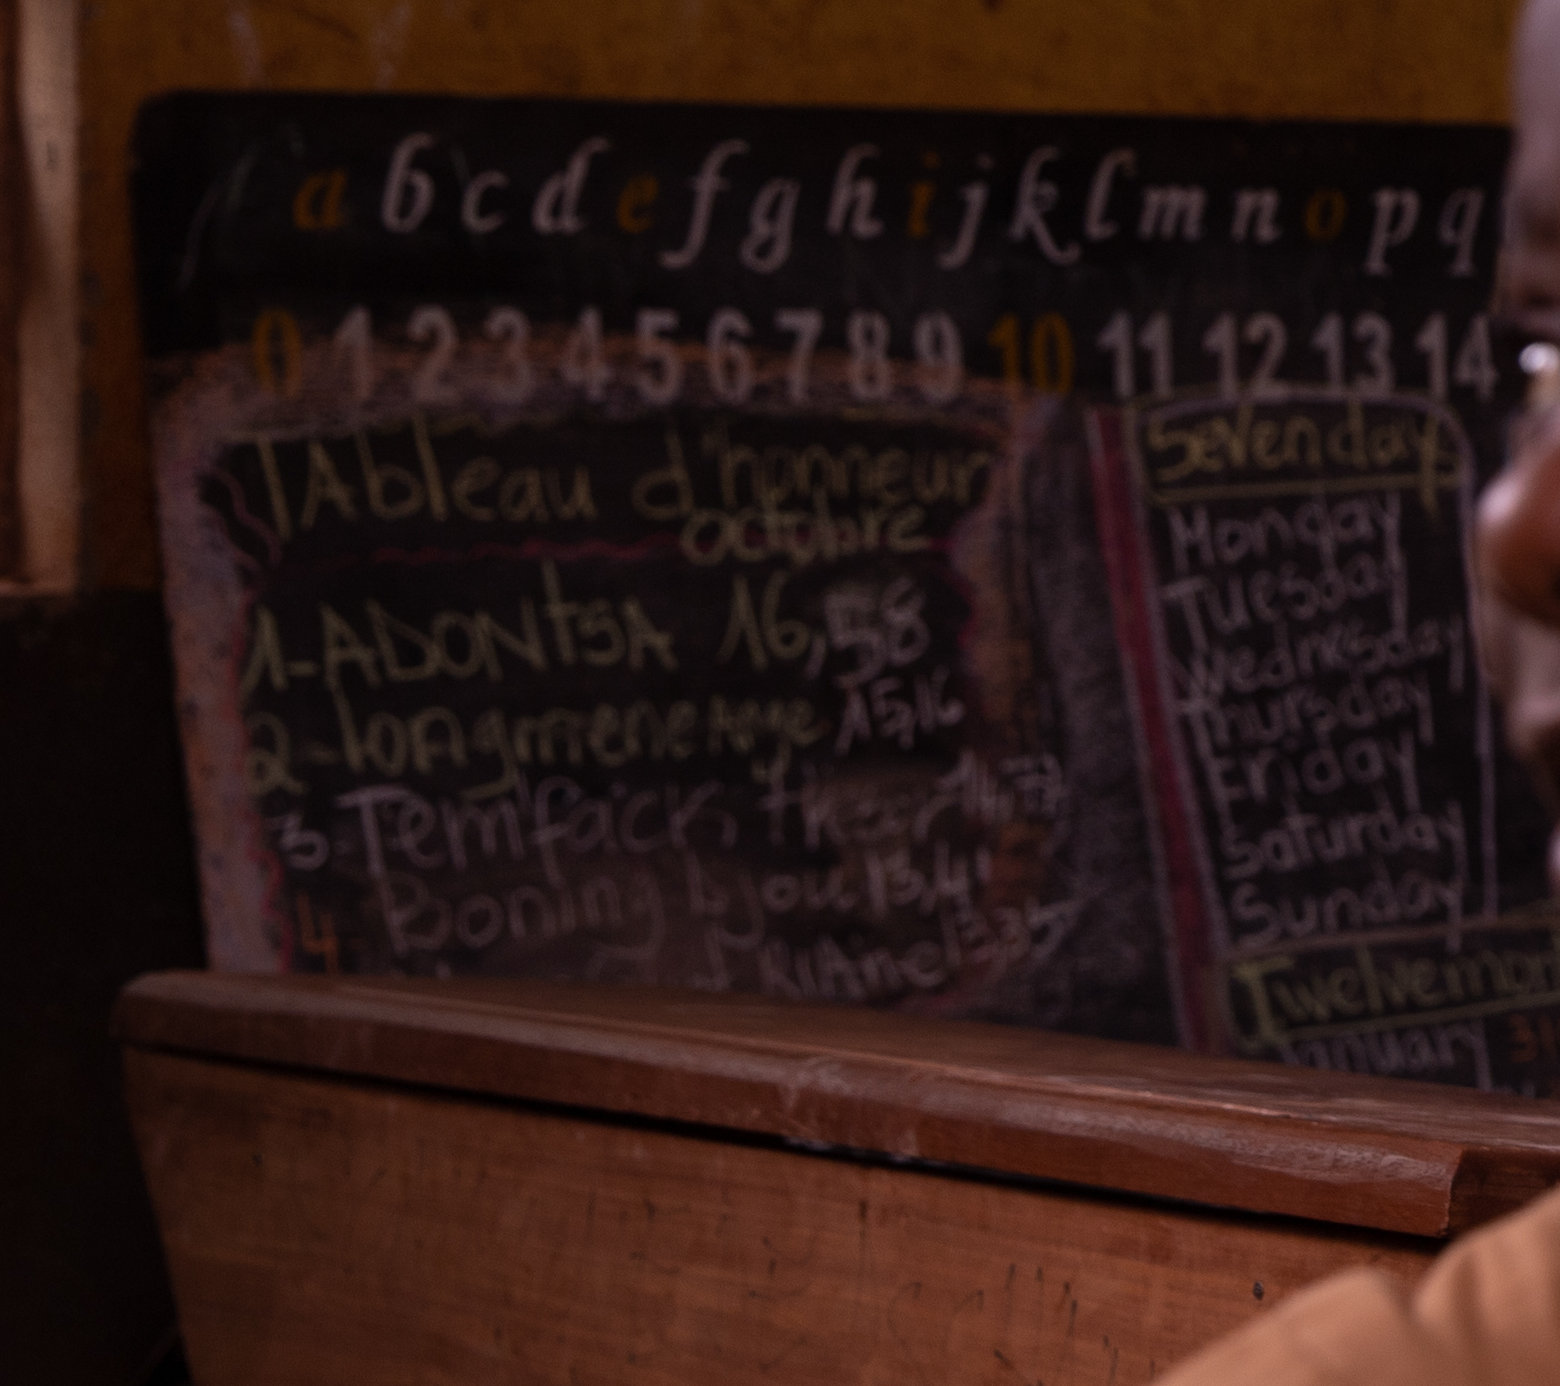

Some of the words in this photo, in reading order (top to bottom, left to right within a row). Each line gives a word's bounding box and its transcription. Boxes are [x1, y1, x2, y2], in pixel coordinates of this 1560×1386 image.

[251, 307, 302, 399] 0
[332, 303, 374, 402] 1
[407, 305, 462, 404] 2
[483, 306, 532, 405] 3
[561, 306, 613, 406] 4
[636, 306, 685, 406] 5
[706, 306, 754, 406] 6
[774, 308, 824, 404] 7
[845, 310, 895, 404] 8
[913, 311, 965, 404] 9
[986, 313, 1075, 396] 10
[1097, 312, 1175, 401] 11
[1203, 312, 1290, 399] 12
[1311, 312, 1395, 401] 13
[1415, 312, 1499, 403] 14
